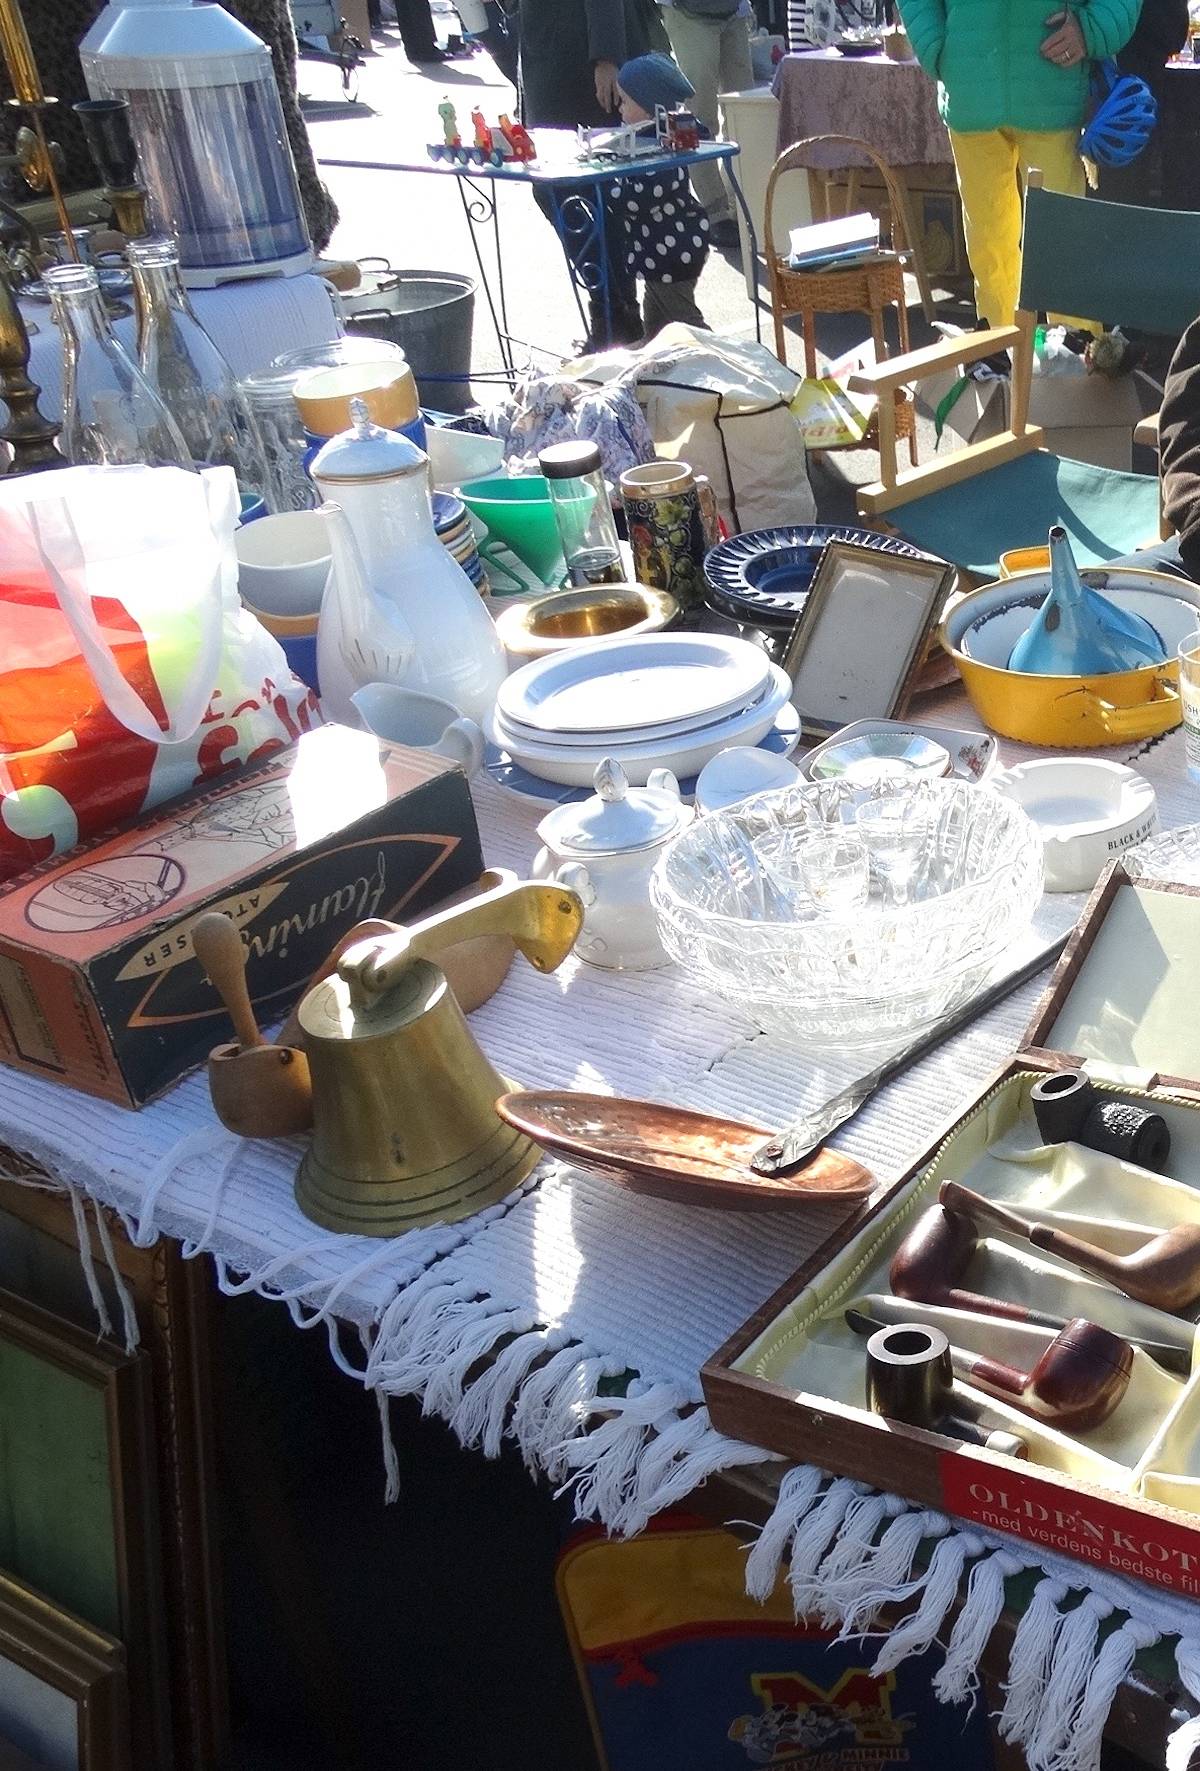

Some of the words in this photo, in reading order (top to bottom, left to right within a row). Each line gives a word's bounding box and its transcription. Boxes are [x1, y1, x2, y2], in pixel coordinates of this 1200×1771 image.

[1107, 832, 1134, 850] BLACK
[225, 850, 388, 972] flamin
[1028, 1523, 1102, 1560] verdens
[1108, 1549, 1173, 1585] bedste
